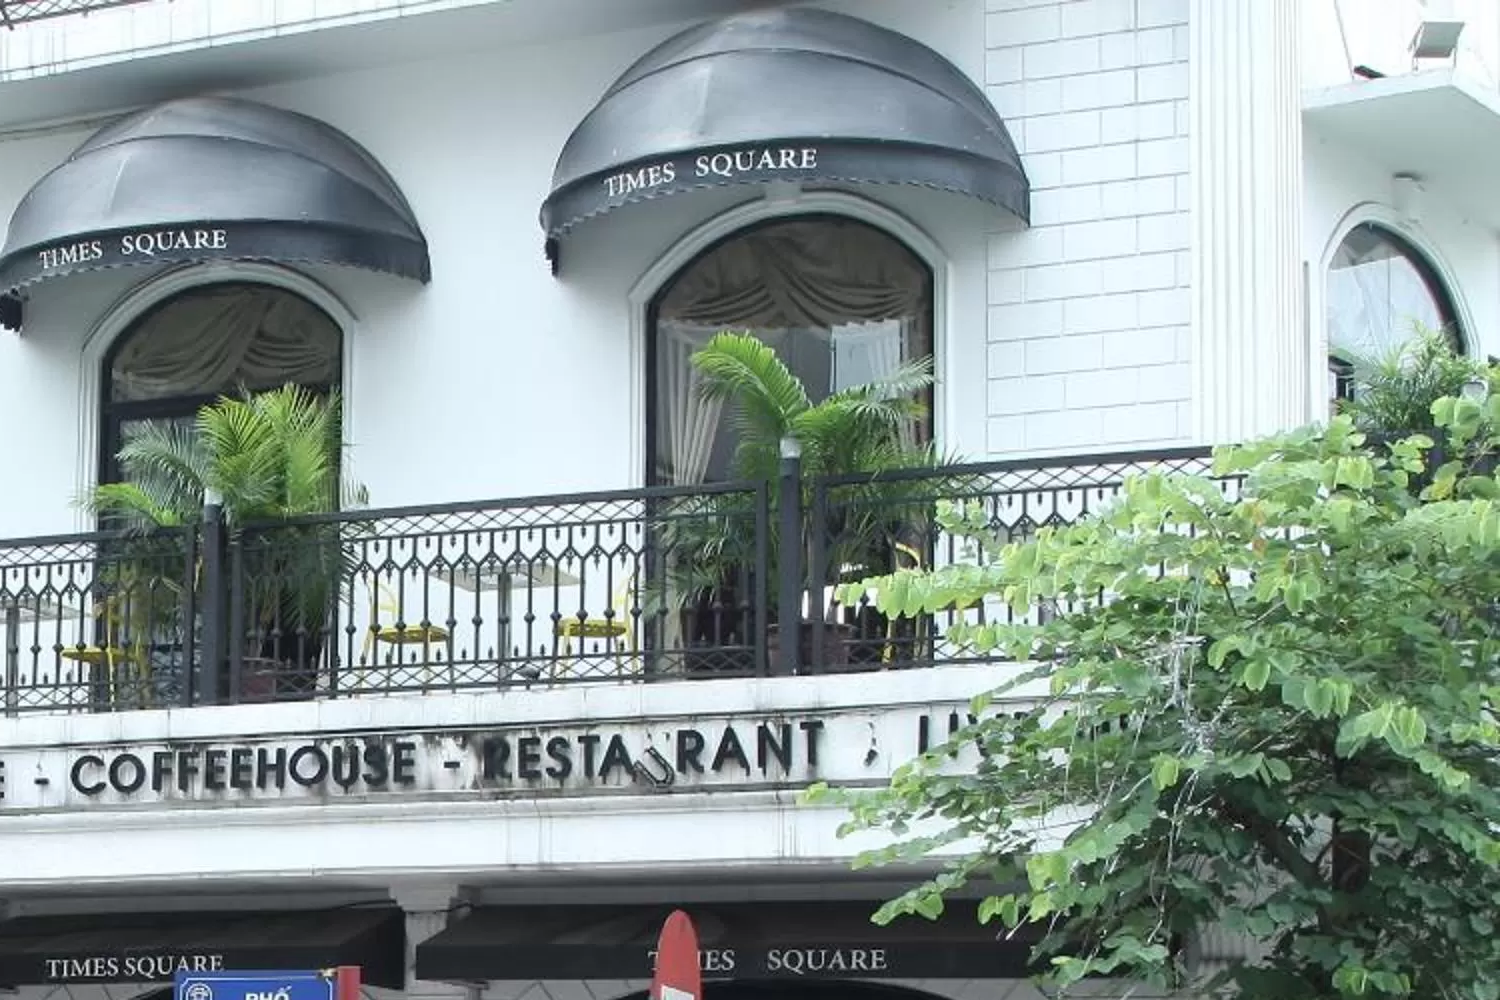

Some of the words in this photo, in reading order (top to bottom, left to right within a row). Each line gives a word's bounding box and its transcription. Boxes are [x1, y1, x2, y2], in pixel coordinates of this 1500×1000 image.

[603, 161, 676, 197] TIMES
[695, 149, 818, 177] SQUARE
[39, 241, 103, 269] TIMES
[121, 230, 227, 255] SQUARE
[70, 741, 416, 796] COFFEEHOUSE
[45, 957, 120, 978] TIMES
[123, 955, 225, 979] SQUARE
[768, 949, 888, 975] SQUARE
